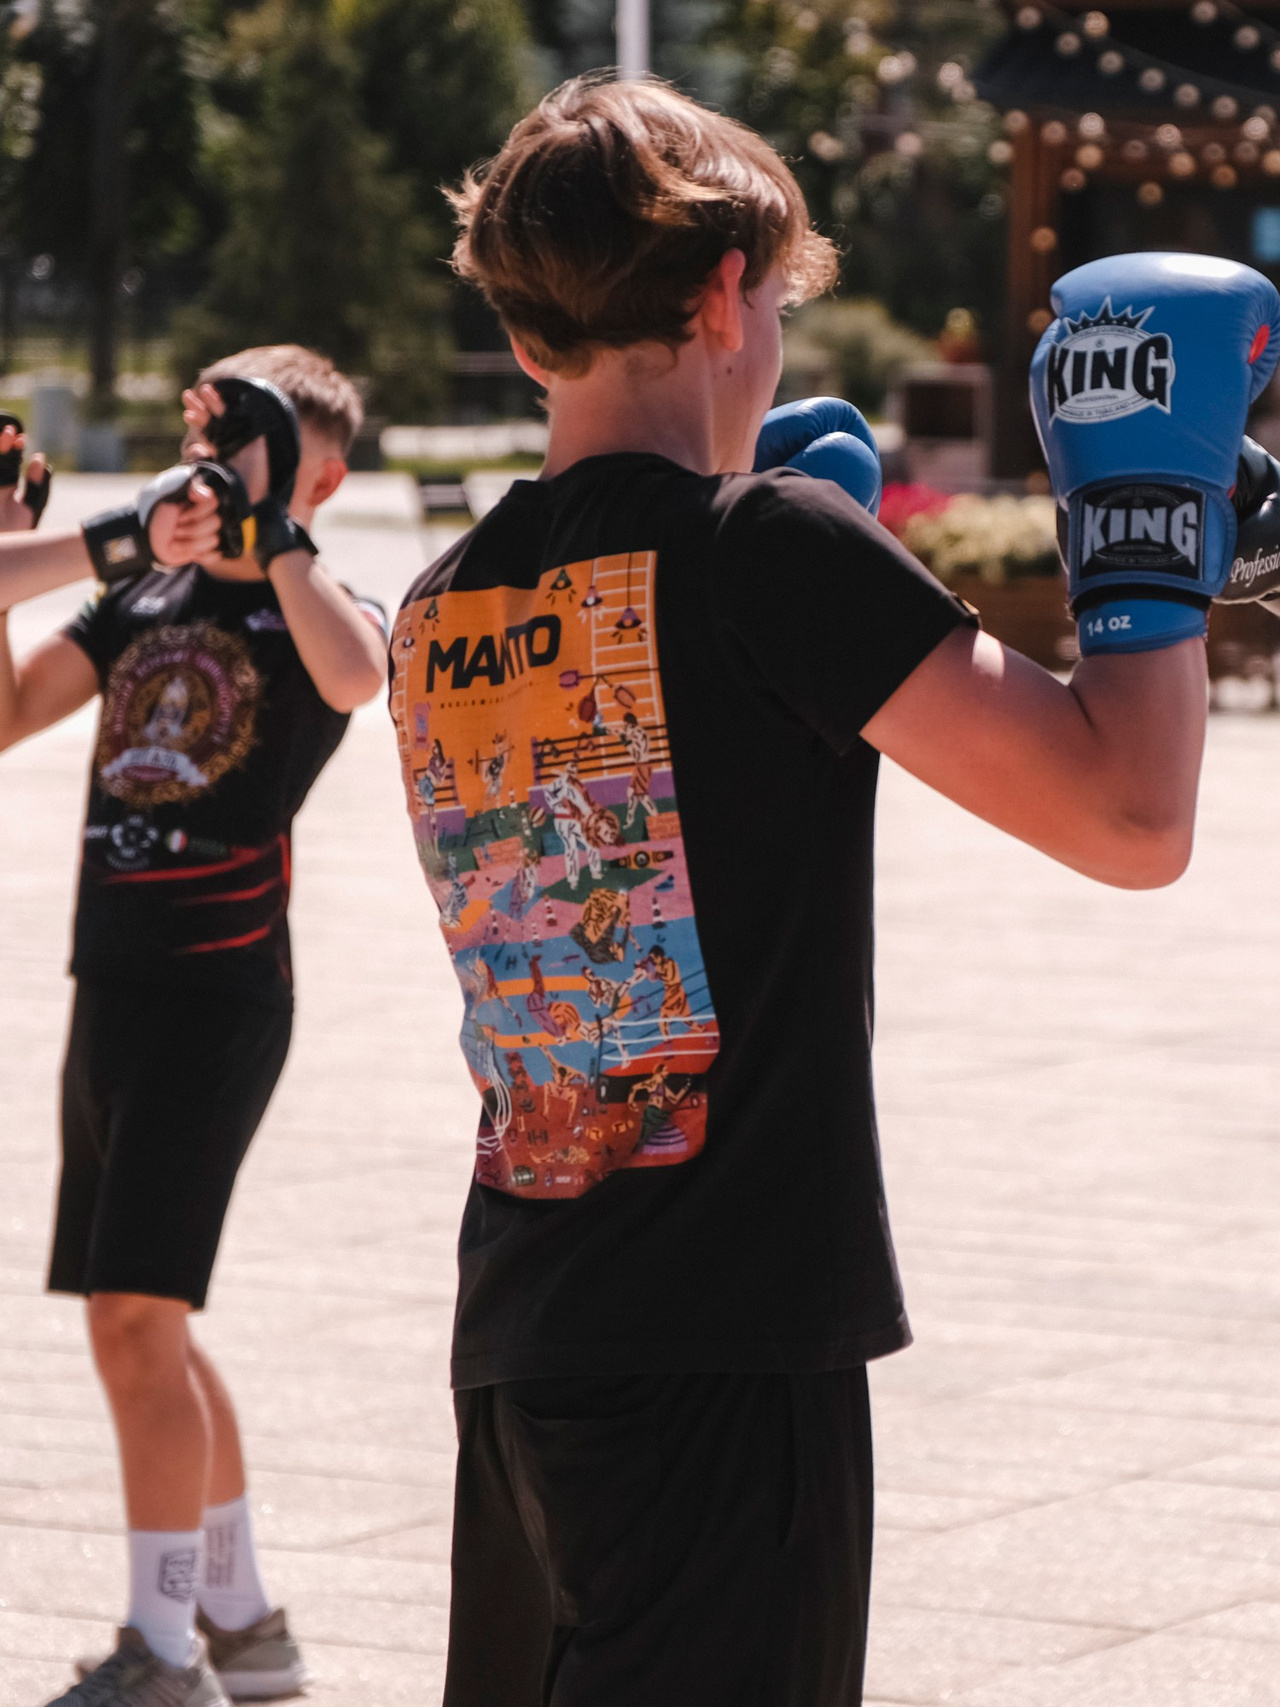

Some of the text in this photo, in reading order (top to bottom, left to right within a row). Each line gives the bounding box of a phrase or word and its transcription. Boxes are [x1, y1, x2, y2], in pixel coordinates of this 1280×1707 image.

[1047, 335, 1169, 418] KING
[1082, 501, 1197, 567] KING
[426, 614, 562, 693] MANTO
[1086, 617, 1104, 637] 14
